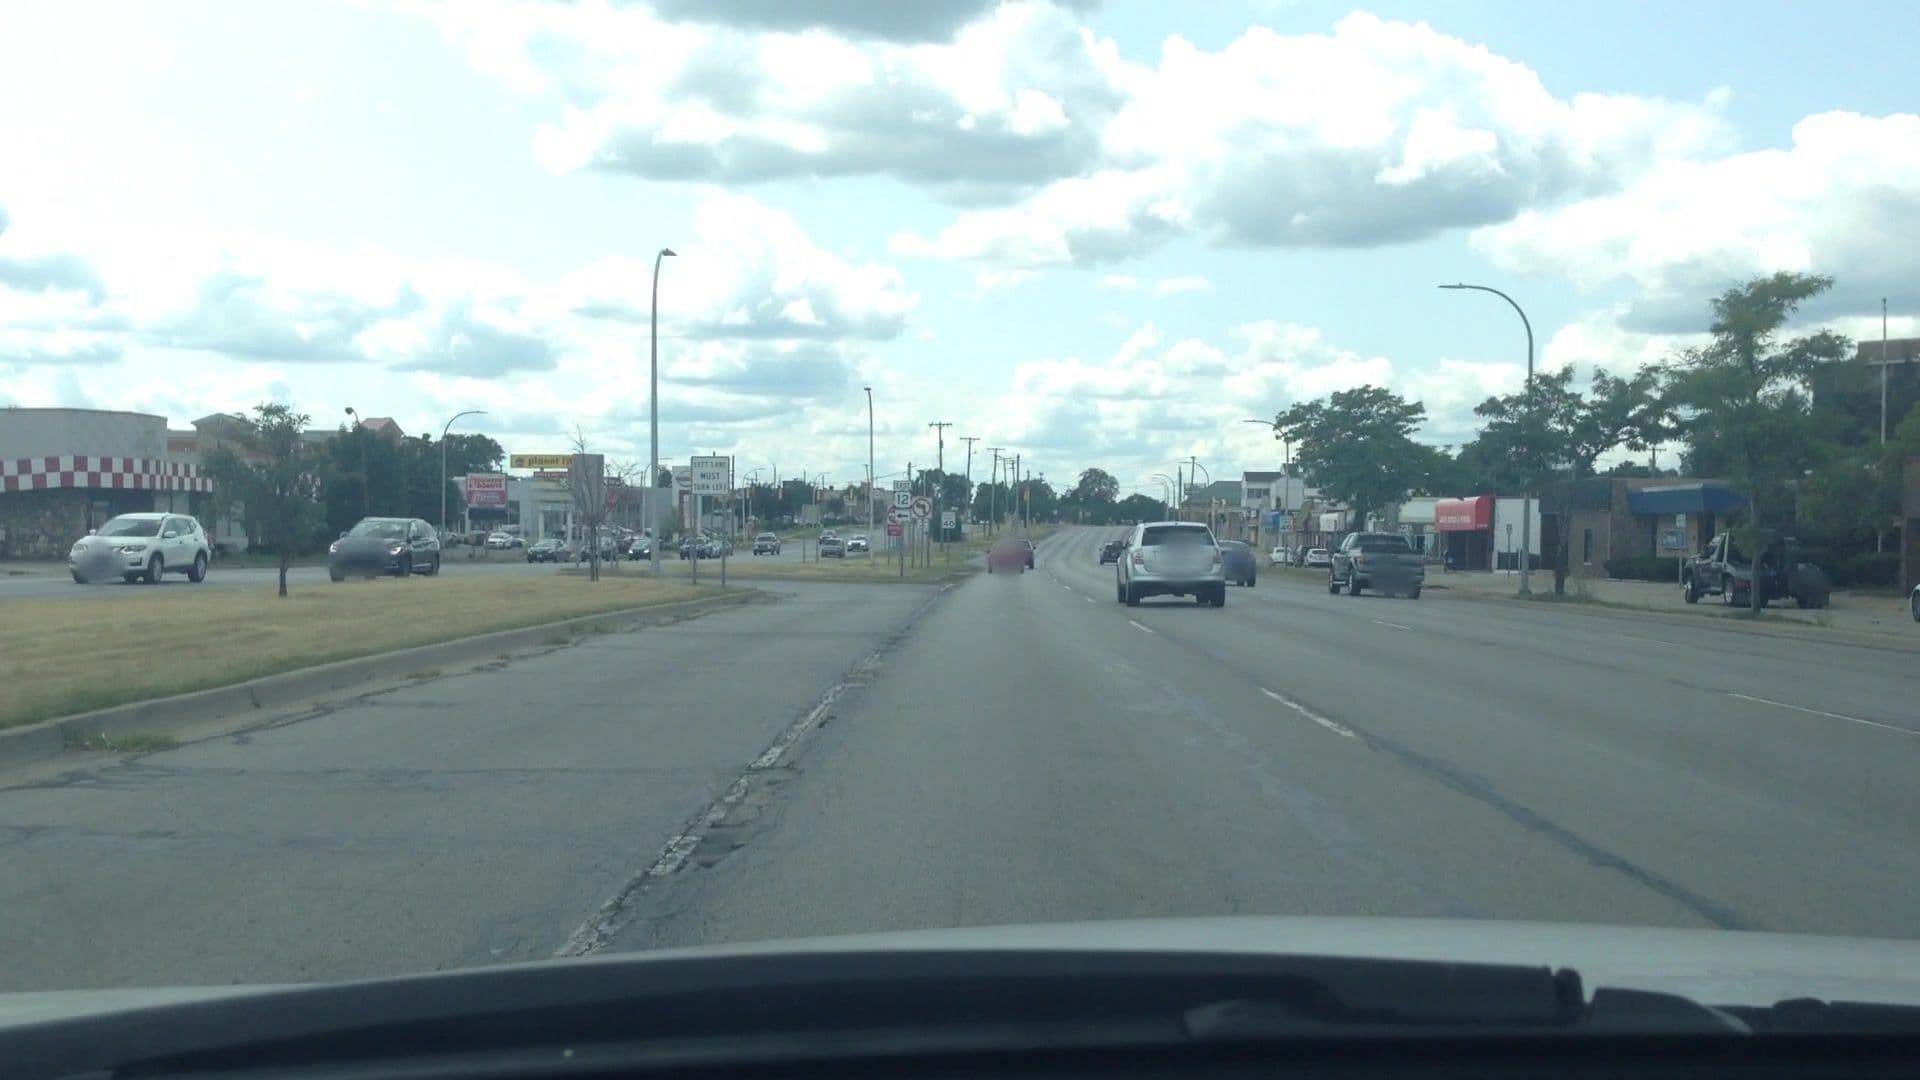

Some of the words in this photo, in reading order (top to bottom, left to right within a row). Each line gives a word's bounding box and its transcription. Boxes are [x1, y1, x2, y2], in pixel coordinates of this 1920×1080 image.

[528, 456, 559, 466] planet
[701, 472, 720, 480] MUST
[897, 494, 909, 505] 12
